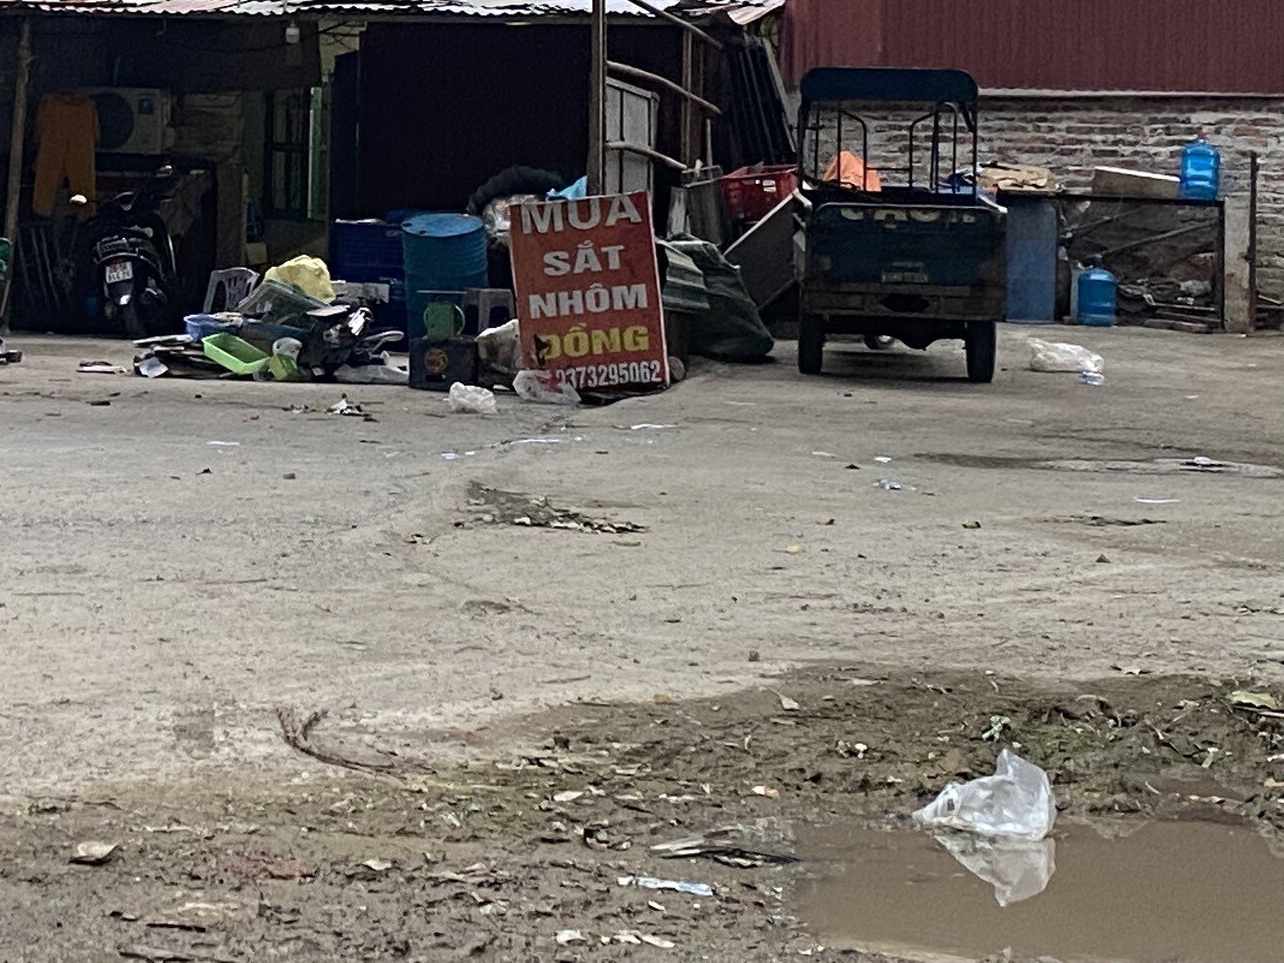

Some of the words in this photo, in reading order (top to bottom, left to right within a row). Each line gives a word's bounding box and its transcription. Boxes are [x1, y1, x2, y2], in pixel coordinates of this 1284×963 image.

[519, 194, 642, 234] MUA
[543, 240, 625, 276] SẮT
[528, 283, 648, 319] NHÔM
